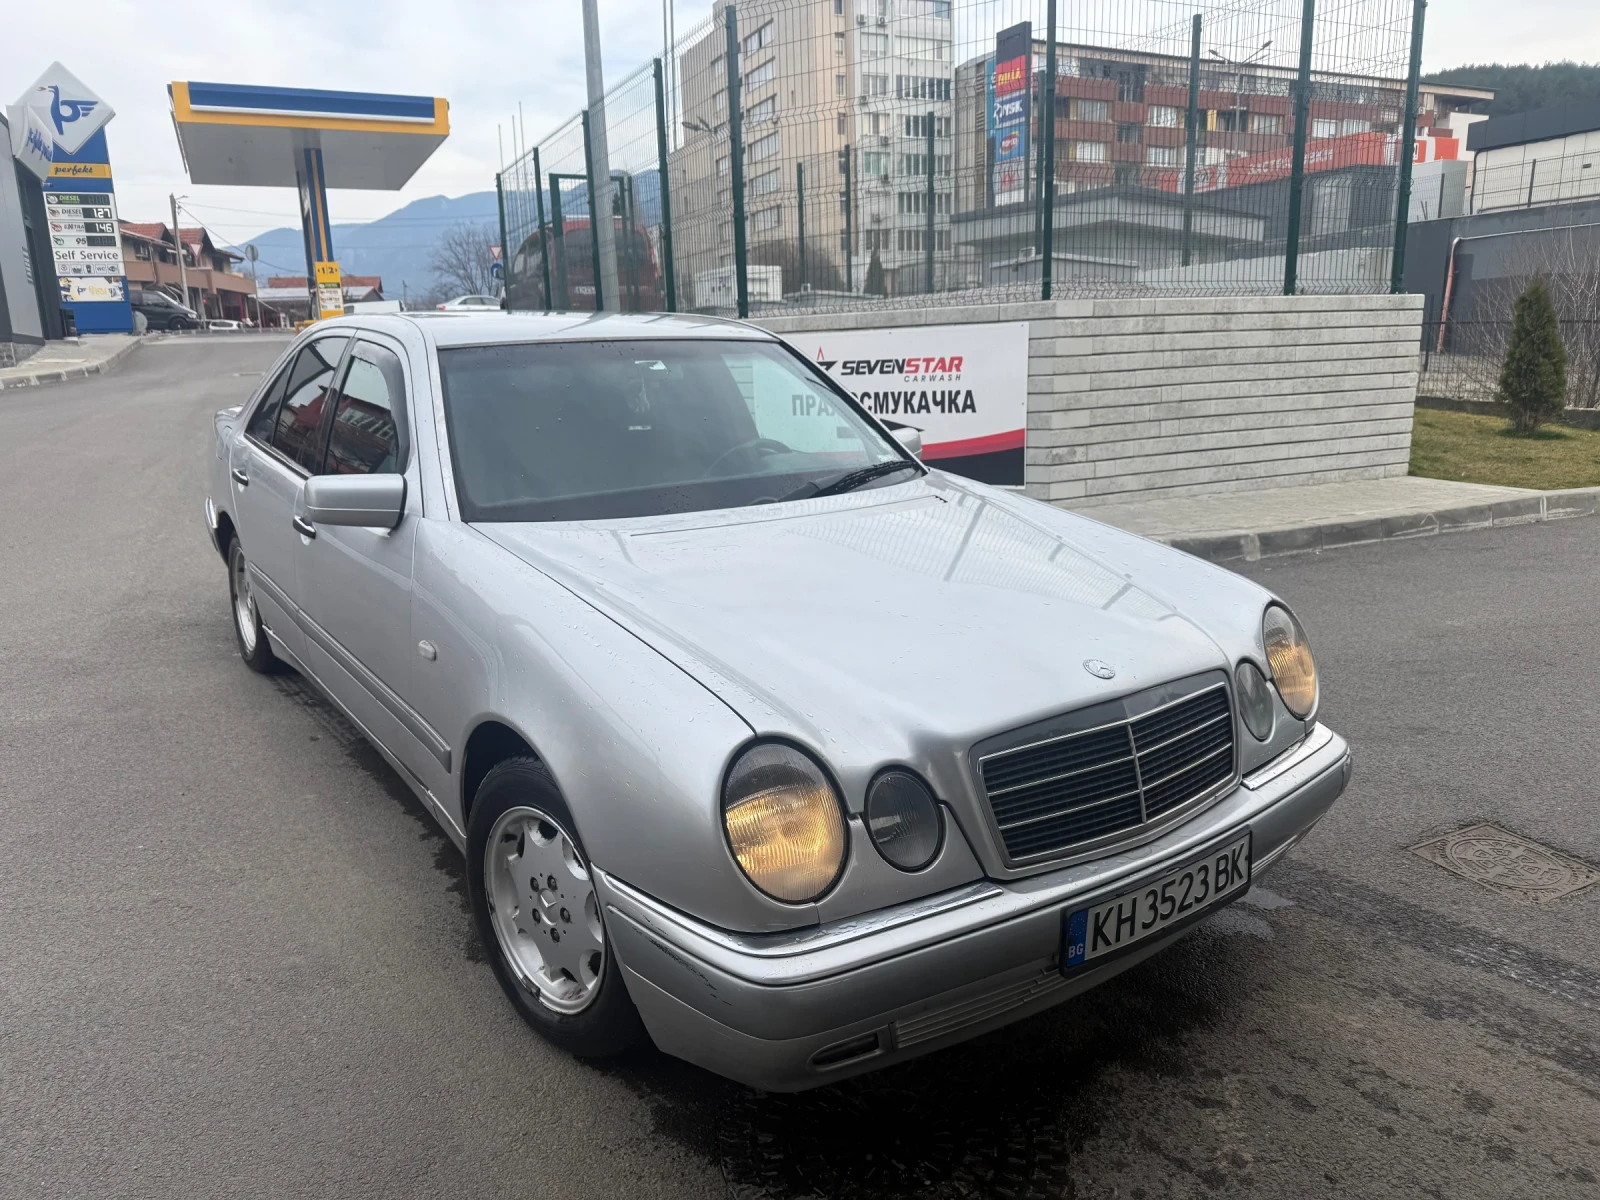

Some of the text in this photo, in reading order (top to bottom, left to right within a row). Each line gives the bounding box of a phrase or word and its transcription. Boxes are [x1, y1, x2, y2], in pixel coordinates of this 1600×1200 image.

[54, 165, 93, 175] perfekt
[75, 237, 87, 245] 95
[55, 250, 119, 260] Self Service
[841, 356, 964, 376] SEVENSTAR
[904, 374, 962, 383] CARWASH
[1068, 942, 1084, 959] BG
